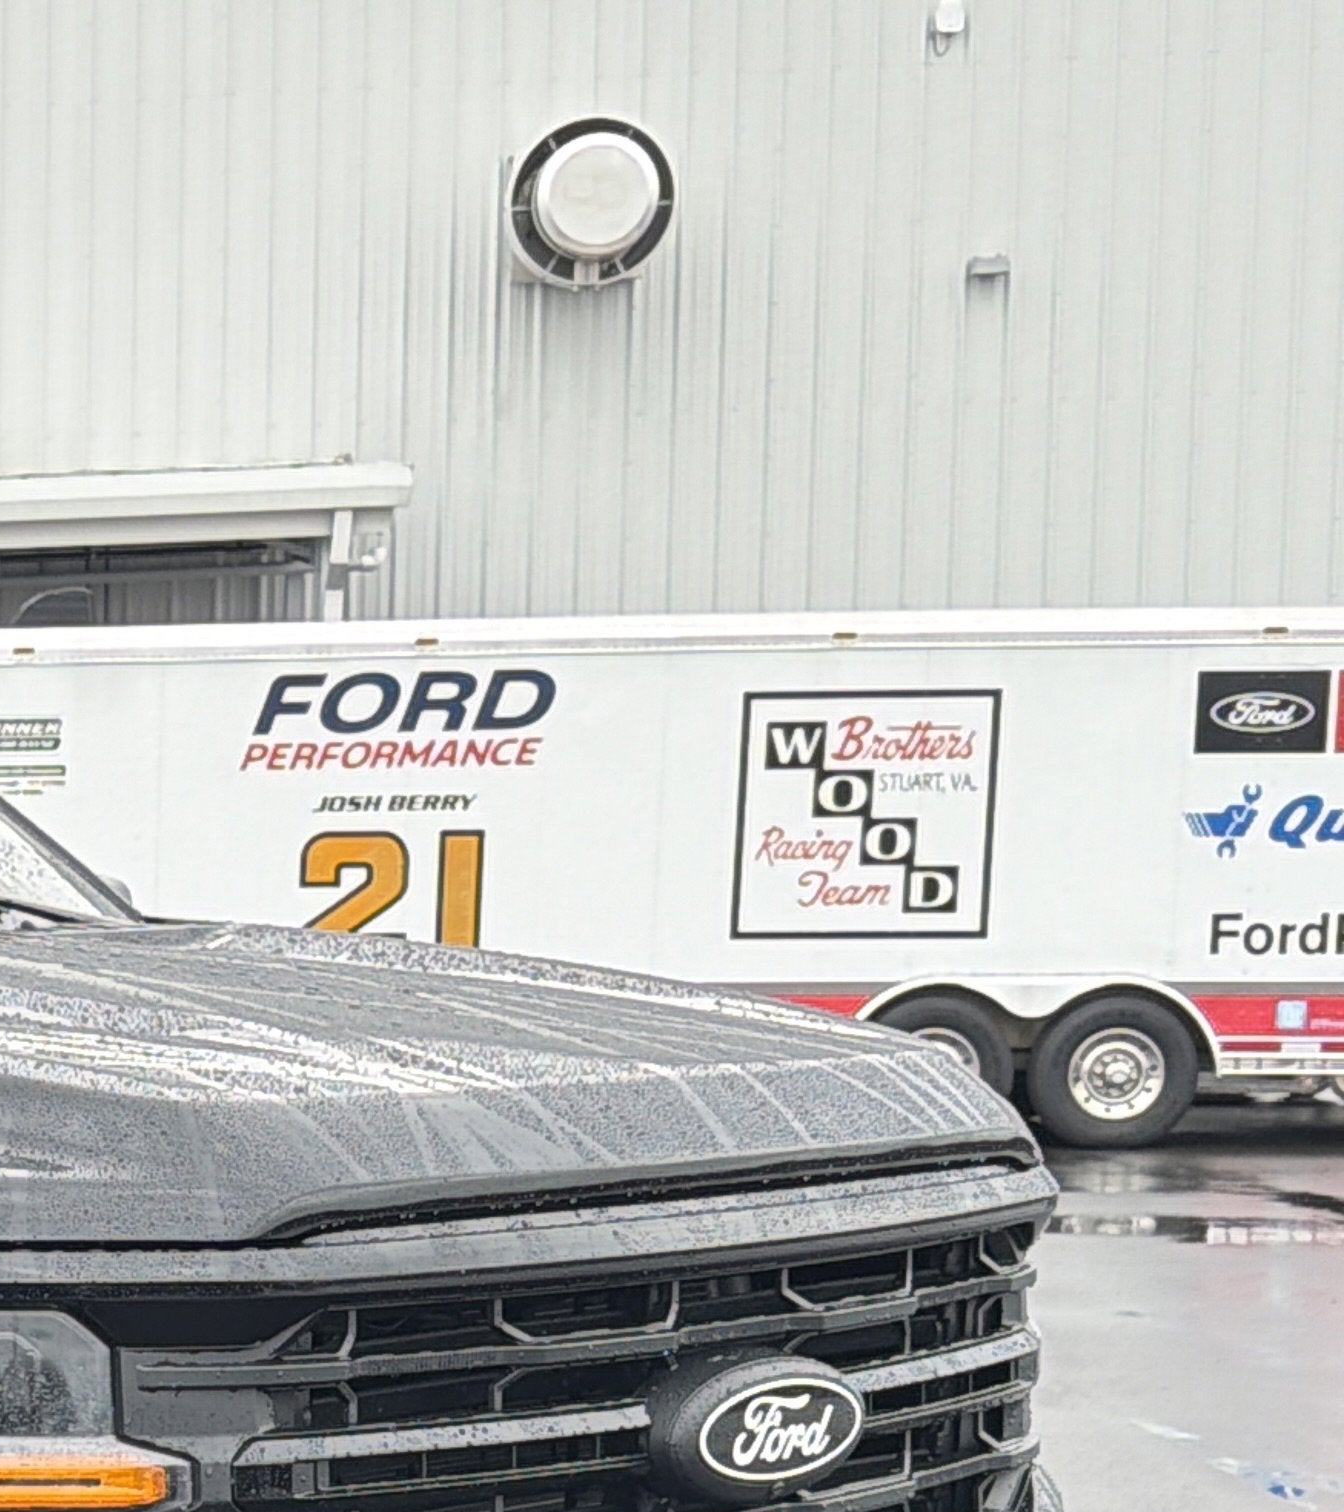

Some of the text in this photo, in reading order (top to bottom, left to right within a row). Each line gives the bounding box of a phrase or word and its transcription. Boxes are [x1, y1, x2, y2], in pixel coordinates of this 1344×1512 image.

[252, 669, 557, 736] FORD
[1228, 697, 1296, 726] Ford
[239, 737, 544, 772] PERFORMANCE
[831, 715, 977, 761] Brothers
[312, 793, 477, 814] JOSH BERRY
[878, 772, 946, 794] STUART,
[754, 825, 854, 872] Racing
[299, 829, 485, 948] 21
[797, 870, 891, 908] Team
[732, 1392, 835, 1467] Ford
